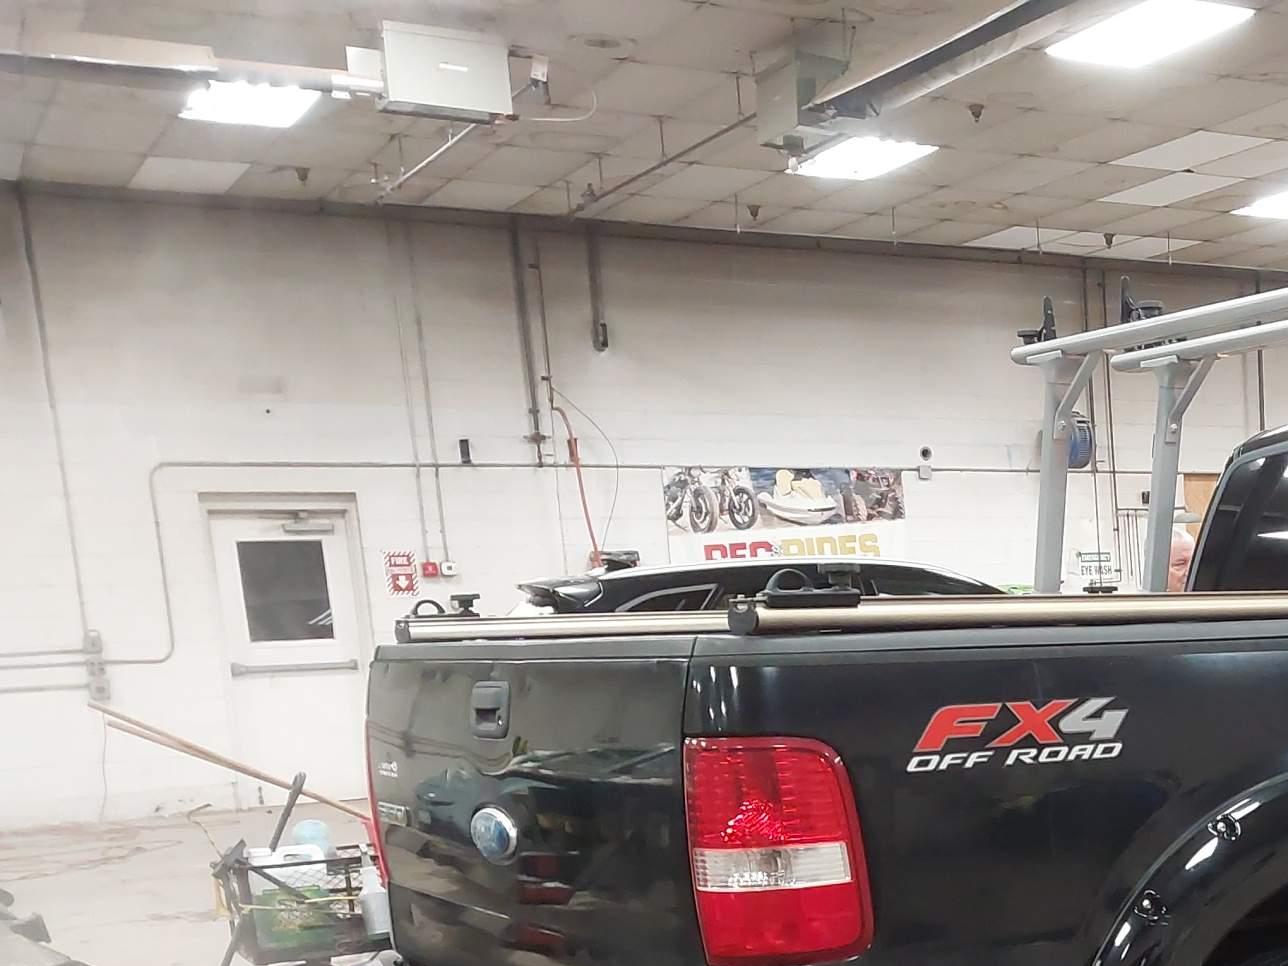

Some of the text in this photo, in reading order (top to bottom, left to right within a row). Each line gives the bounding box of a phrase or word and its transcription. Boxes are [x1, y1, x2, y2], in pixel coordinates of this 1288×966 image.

[1081, 565, 1093, 576] EYE
[913, 696, 1129, 753] FX4
[906, 742, 1123, 772] OFF ROAD
